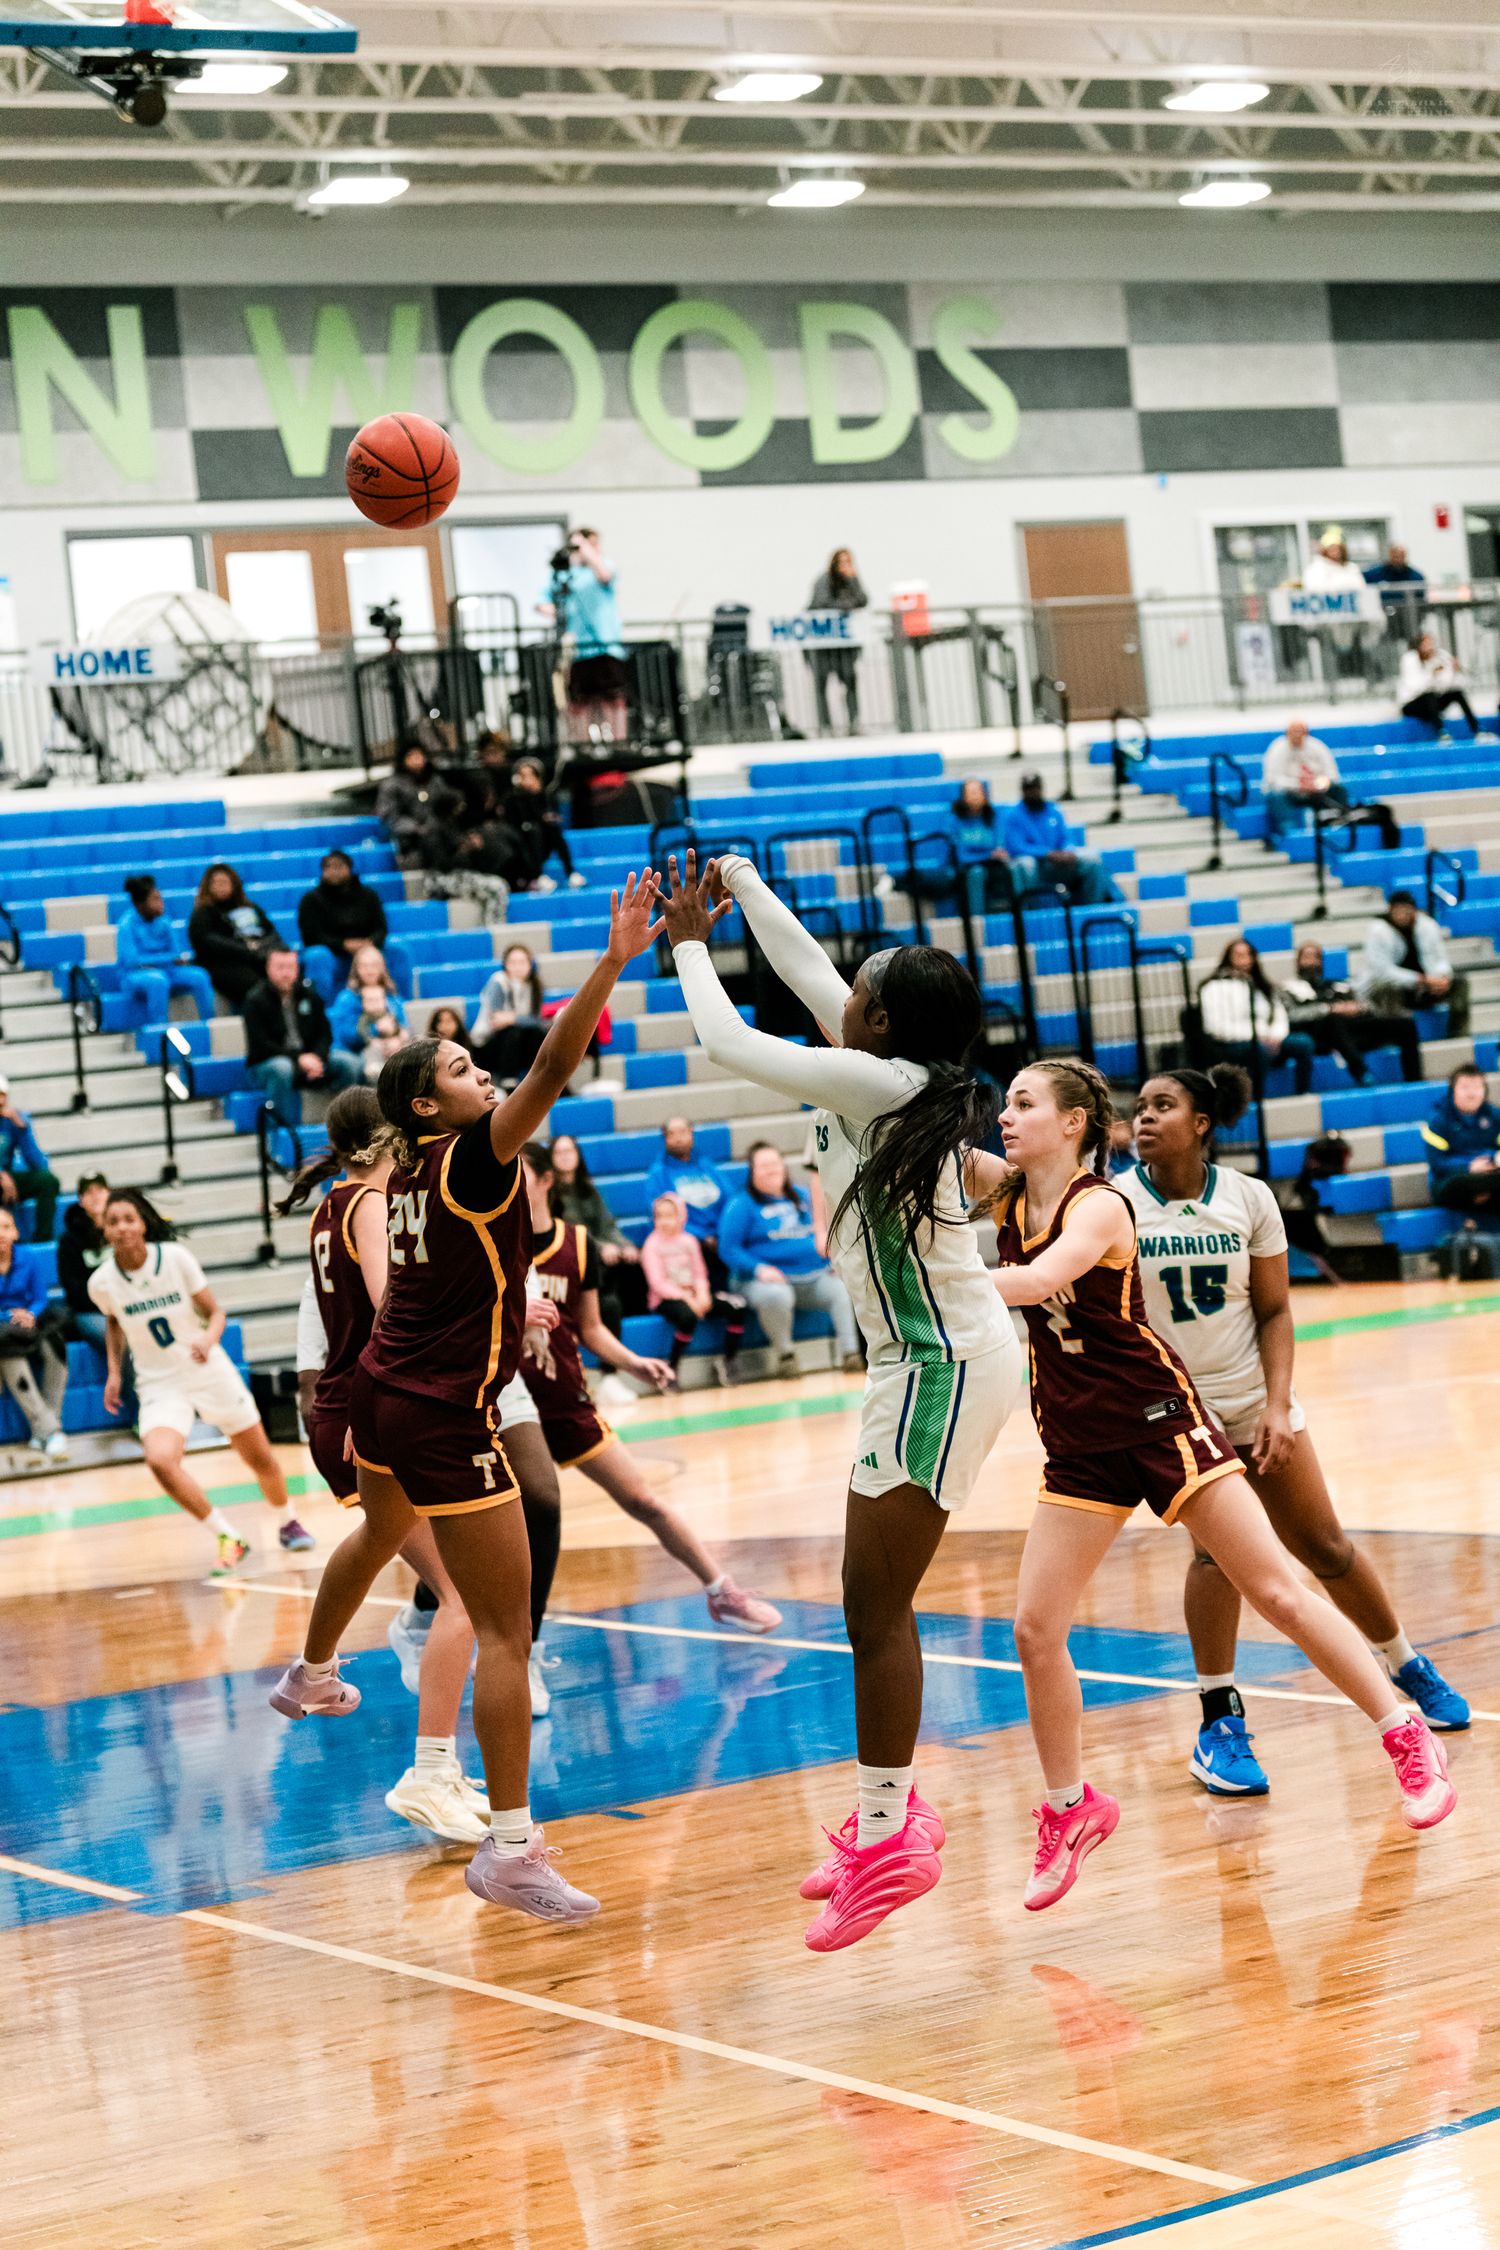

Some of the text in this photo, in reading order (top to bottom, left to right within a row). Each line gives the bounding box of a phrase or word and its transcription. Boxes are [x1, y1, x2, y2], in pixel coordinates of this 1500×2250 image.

[7, 295, 1021, 484] N WOODS
[1289, 591, 1359, 615] HOME
[768, 614, 853, 641] HOME
[54, 648, 153, 676] HOME
[387, 1189, 430, 1266] 24
[1138, 1232, 1241, 1259] WARRIORS
[123, 1292, 181, 1316] WARRIORS
[1158, 1264, 1228, 1324] 15
[147, 1316, 176, 1349] 0
[1169, 1402, 1176, 1411] S
[1189, 1424, 1224, 1461] T
[471, 1451, 498, 1490] T
